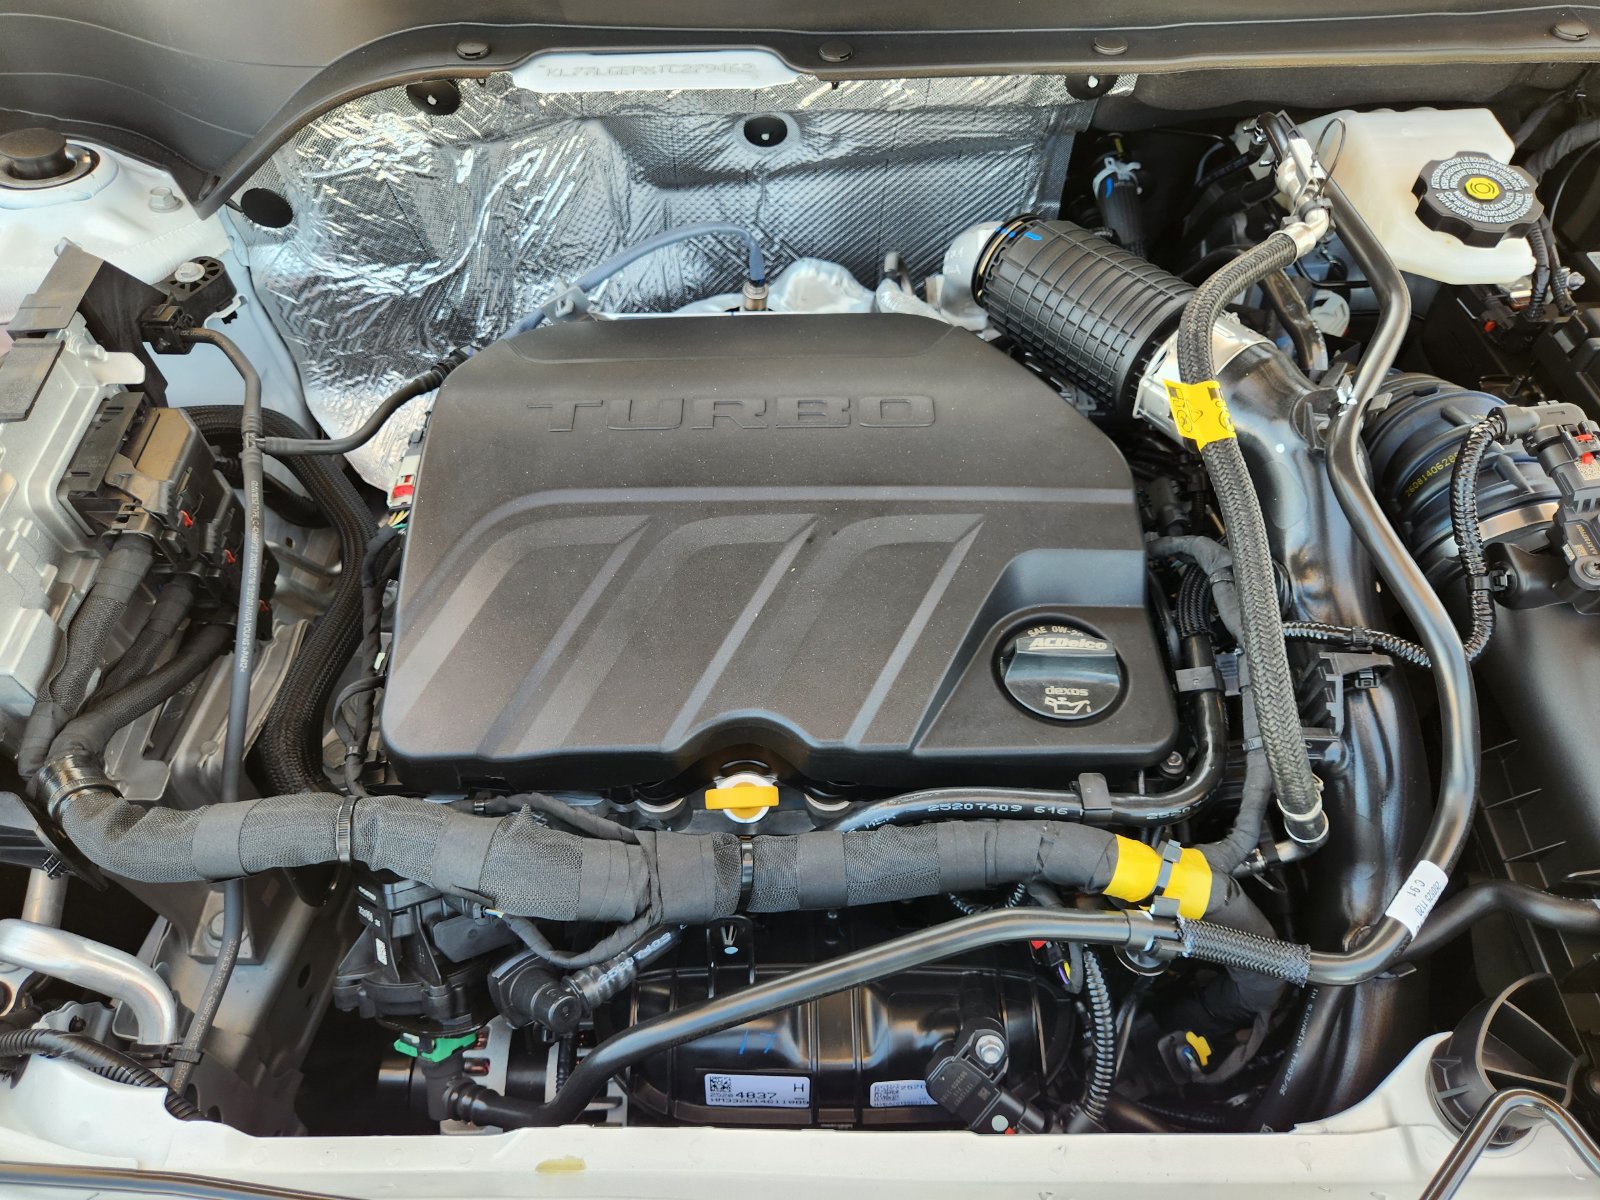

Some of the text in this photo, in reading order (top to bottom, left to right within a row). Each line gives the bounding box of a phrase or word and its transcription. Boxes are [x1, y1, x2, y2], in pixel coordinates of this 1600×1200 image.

[527, 394, 936, 432] TURBO
[1027, 625, 1047, 637] SAE
[1029, 637, 1108, 650] ACDelco
[1045, 686, 1089, 697] dexos
[928, 803, 1023, 813] 25207409
[1033, 805, 1069, 815] 616
[793, 1083, 805, 1093] H
[735, 1091, 777, 1099] 4837
